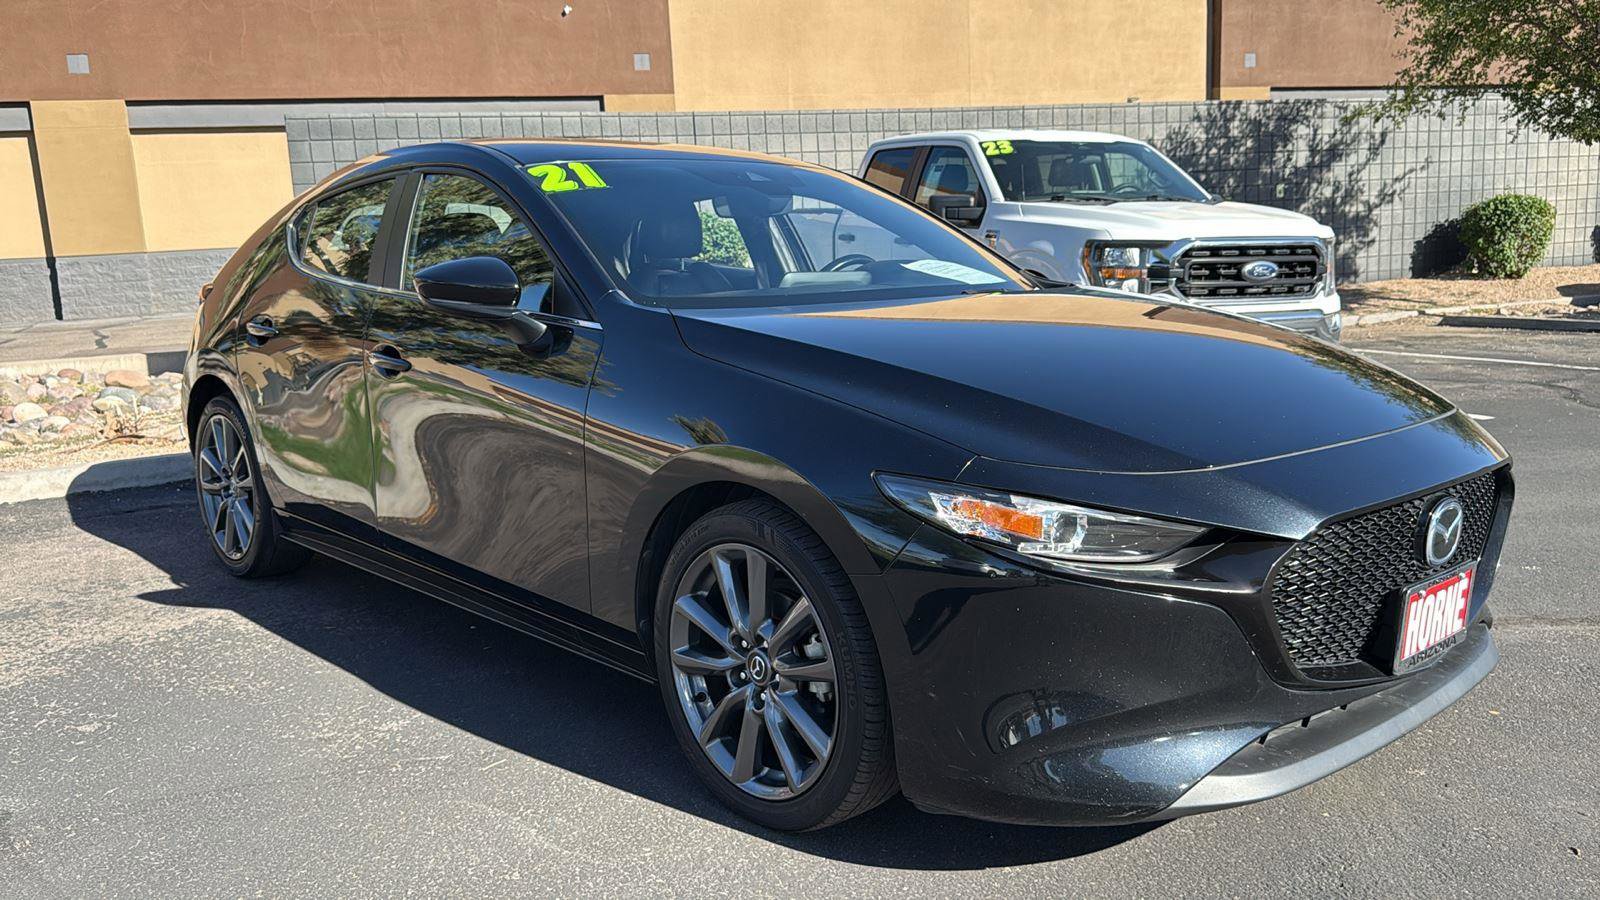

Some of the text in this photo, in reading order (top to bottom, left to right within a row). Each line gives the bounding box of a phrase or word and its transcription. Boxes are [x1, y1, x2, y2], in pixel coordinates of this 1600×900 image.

[981, 140, 1014, 156] 23
[527, 162, 607, 192] 21
[1403, 577, 1469, 660] HORNE
[1407, 635, 1457, 667] ARIZONA
